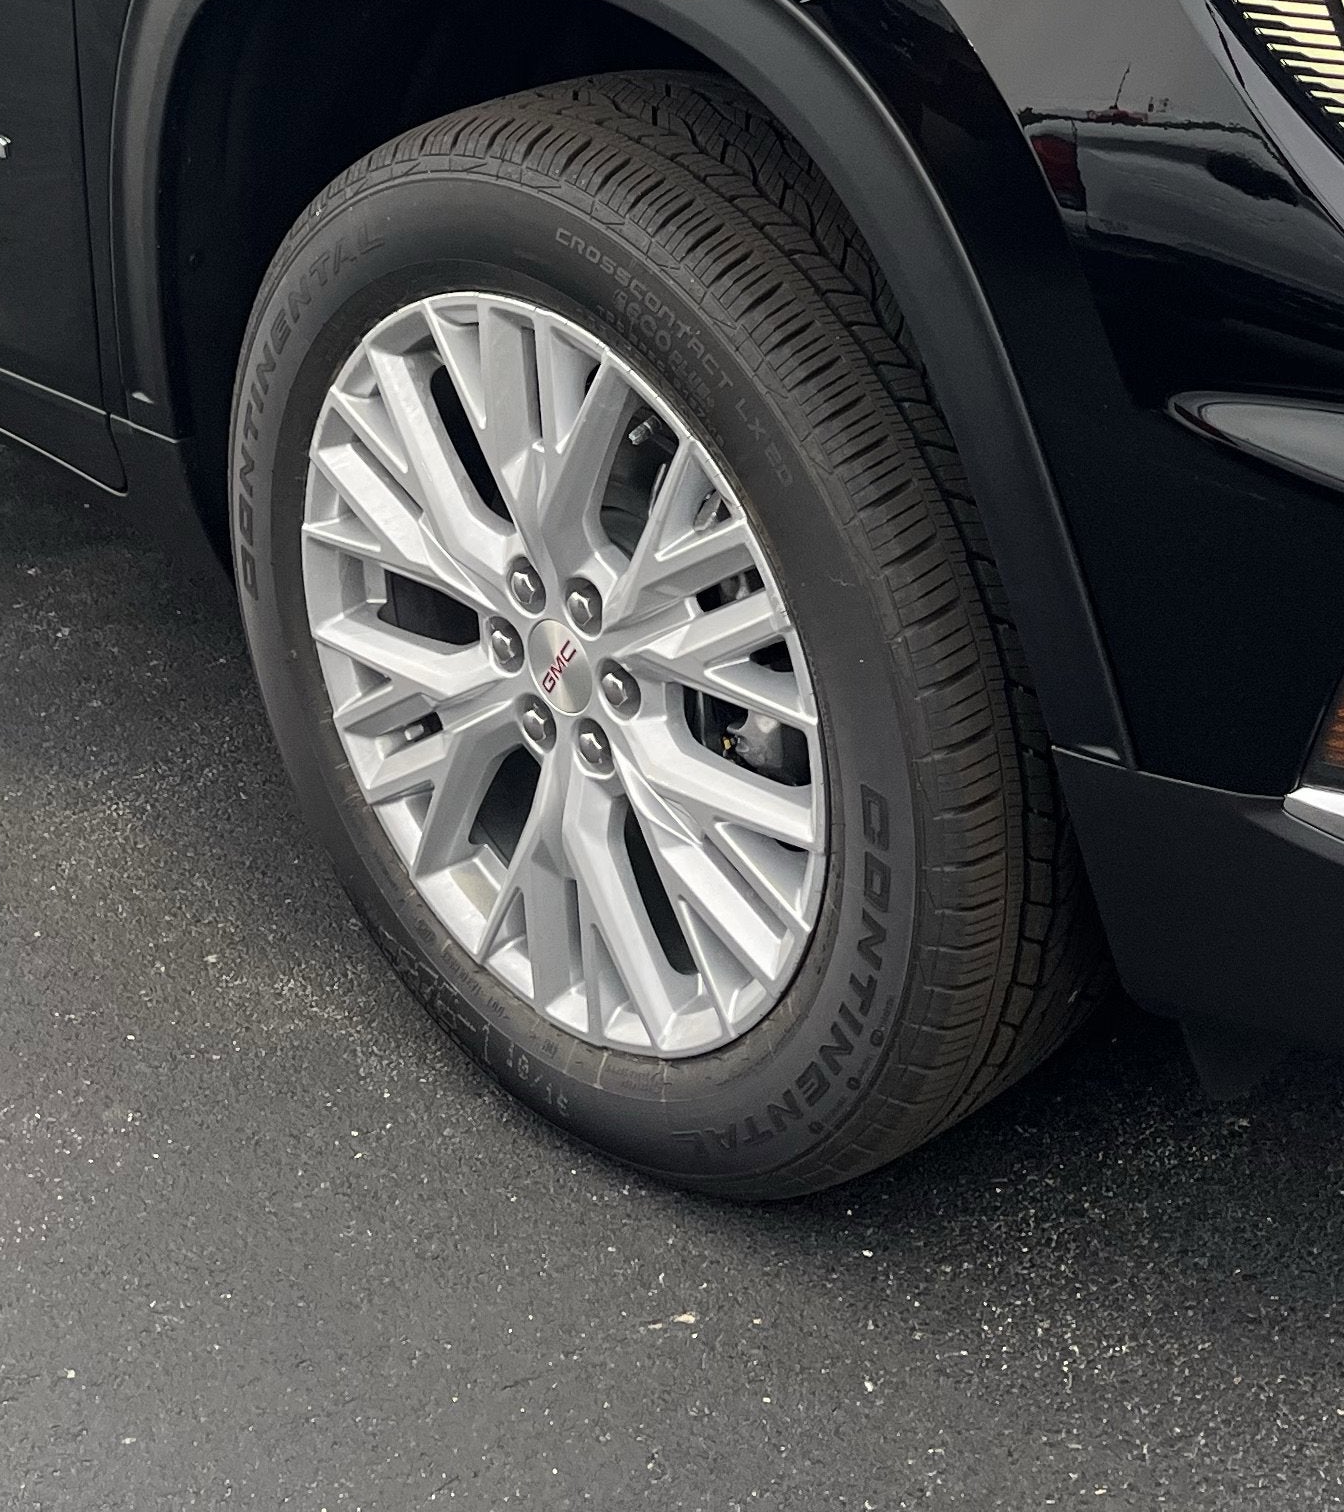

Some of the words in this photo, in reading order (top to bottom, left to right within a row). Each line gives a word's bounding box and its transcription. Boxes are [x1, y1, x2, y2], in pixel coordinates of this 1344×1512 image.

[239, 222, 386, 601] CONTINENTAL
[555, 227, 734, 389] CROSSCONTACT
[541, 639, 577, 694] GMC
[670, 783, 892, 1151] CONTINENTAL
